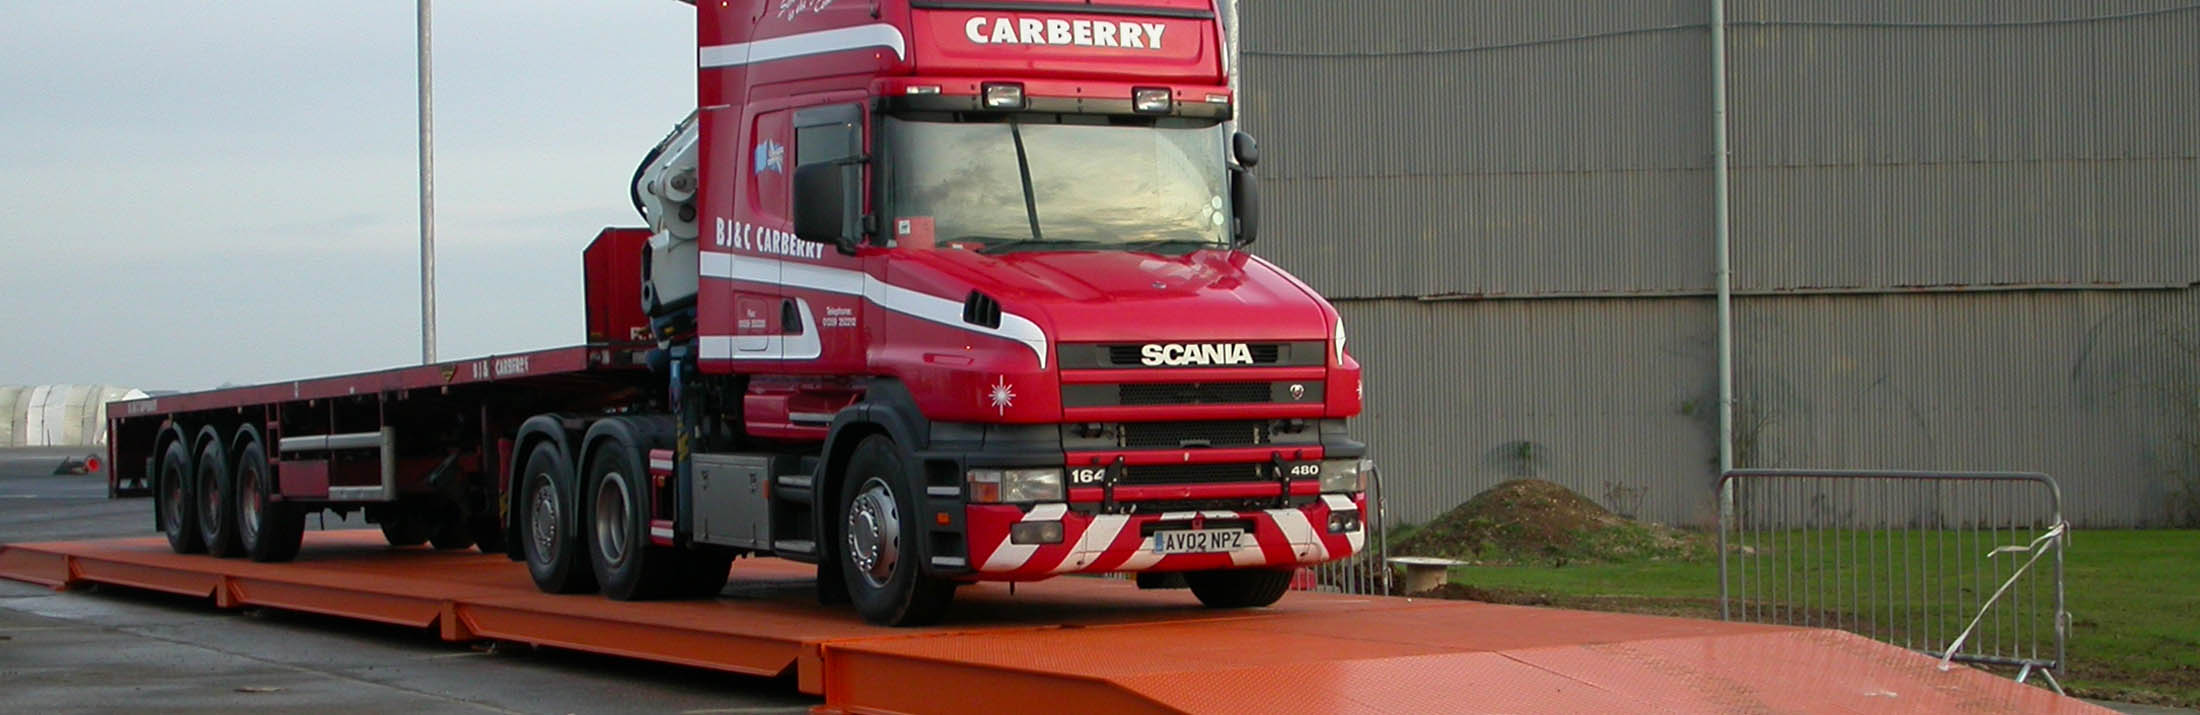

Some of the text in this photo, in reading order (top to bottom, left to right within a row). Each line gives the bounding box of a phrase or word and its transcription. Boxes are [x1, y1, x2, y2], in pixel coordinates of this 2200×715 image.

[965, 17, 1166, 49] CARBERRY
[756, 226, 825, 260] CARBERRY
[1141, 343, 1253, 365] SCANIA
[1072, 469, 1106, 483] 164
[1290, 464, 1319, 476] 480
[1166, 531, 1241, 551] AV02 NPZ
